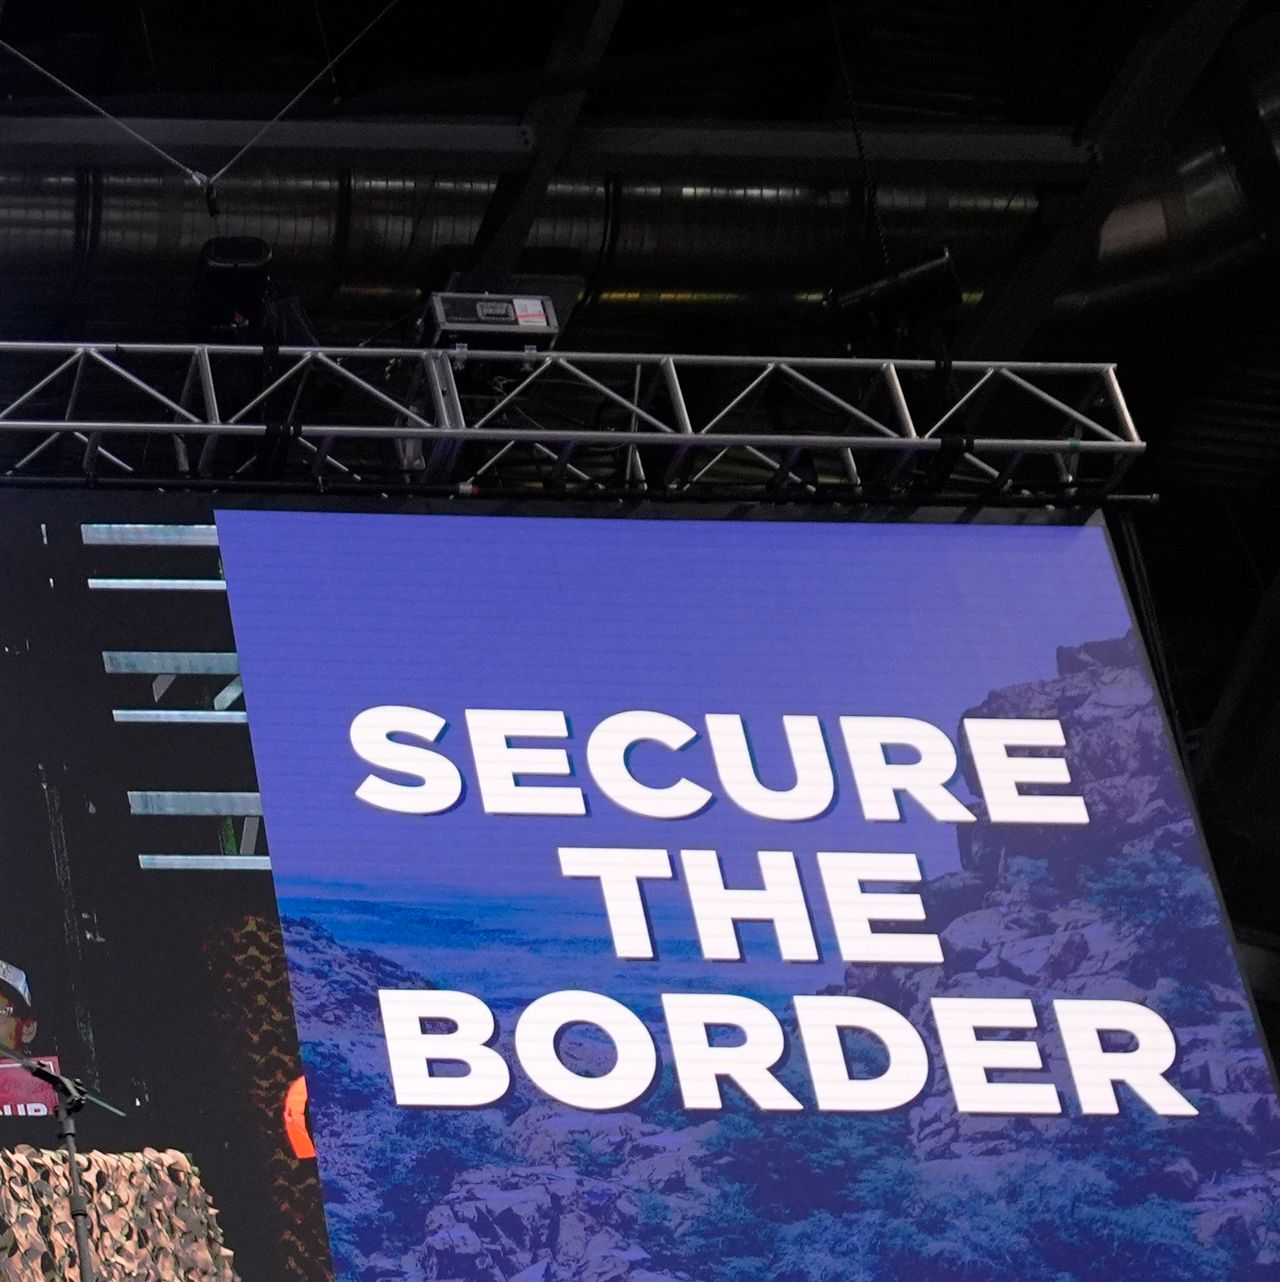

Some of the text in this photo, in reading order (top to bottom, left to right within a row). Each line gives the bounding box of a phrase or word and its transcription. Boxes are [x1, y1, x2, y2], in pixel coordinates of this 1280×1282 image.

[349, 704, 1090, 824] SECURE
[557, 846, 945, 964] THE
[377, 988, 1200, 1117] BORDER
